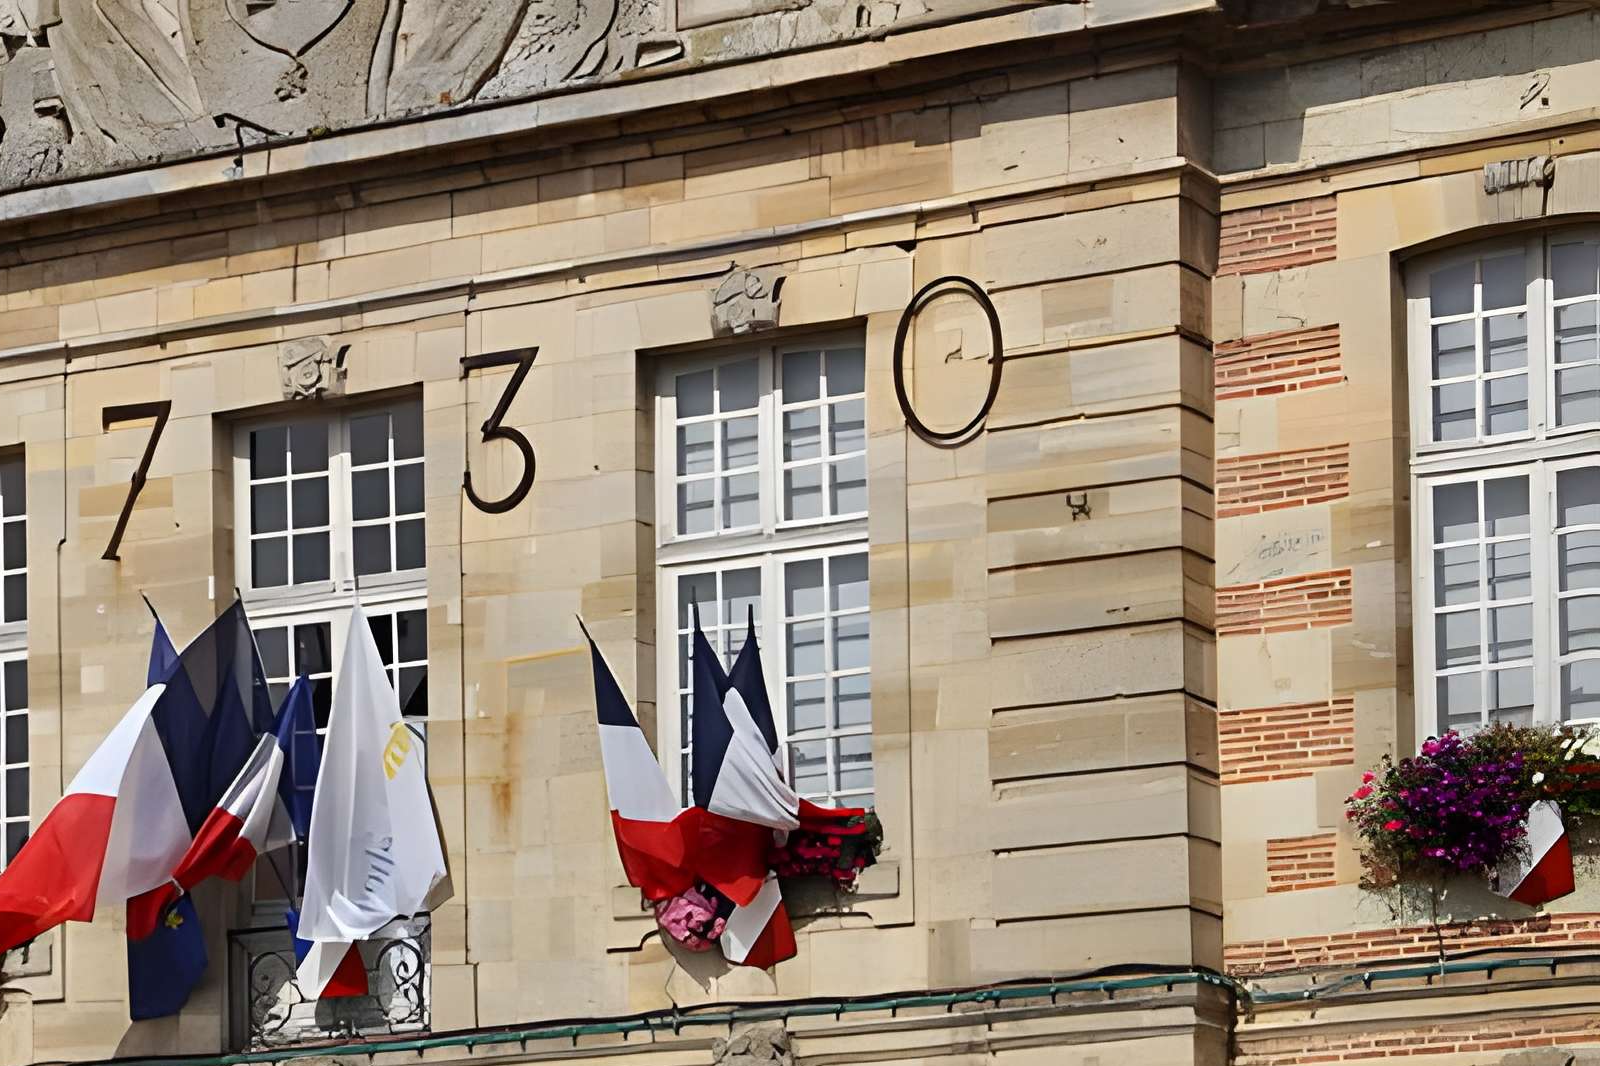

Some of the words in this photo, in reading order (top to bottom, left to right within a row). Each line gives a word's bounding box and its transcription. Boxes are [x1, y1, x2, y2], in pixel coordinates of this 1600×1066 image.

[101, 399, 173, 562] 7
[459, 345, 540, 515] 3
[893, 275, 1004, 449] 0
